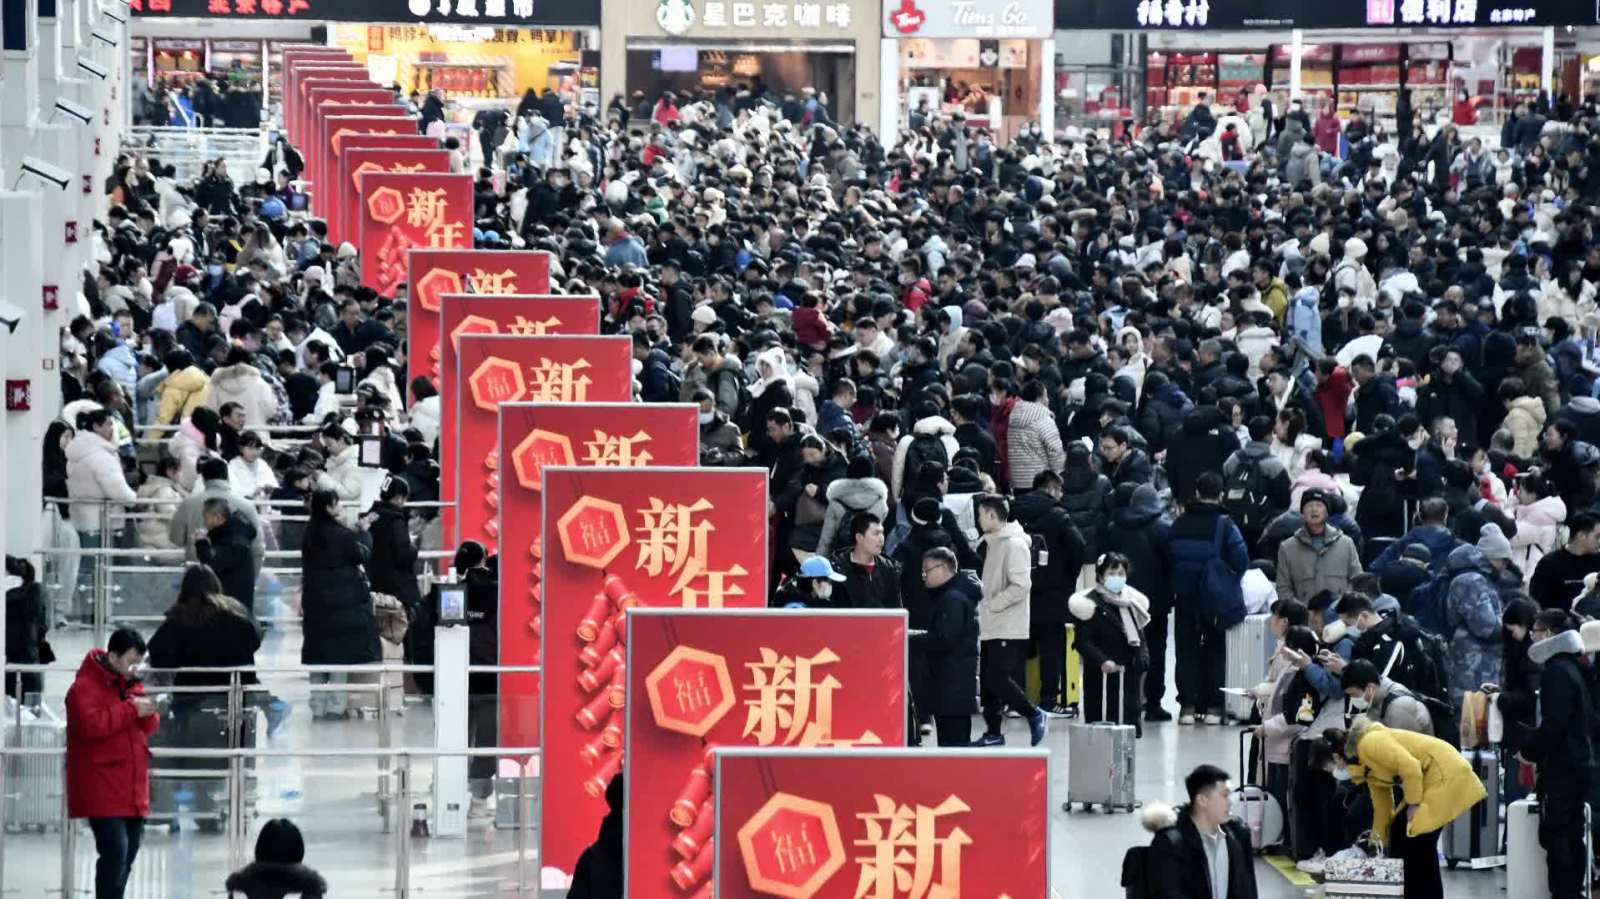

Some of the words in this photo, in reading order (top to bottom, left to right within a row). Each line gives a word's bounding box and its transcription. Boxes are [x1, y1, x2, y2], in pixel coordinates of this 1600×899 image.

[703, 2, 850, 27] 星巴克咖啡
[951, 1, 994, 25] Tims
[1001, 0, 1028, 24] Go
[1400, 0, 1478, 23] 便利店
[742, 647, 884, 747] 新
[853, 794, 1012, 899] 新
